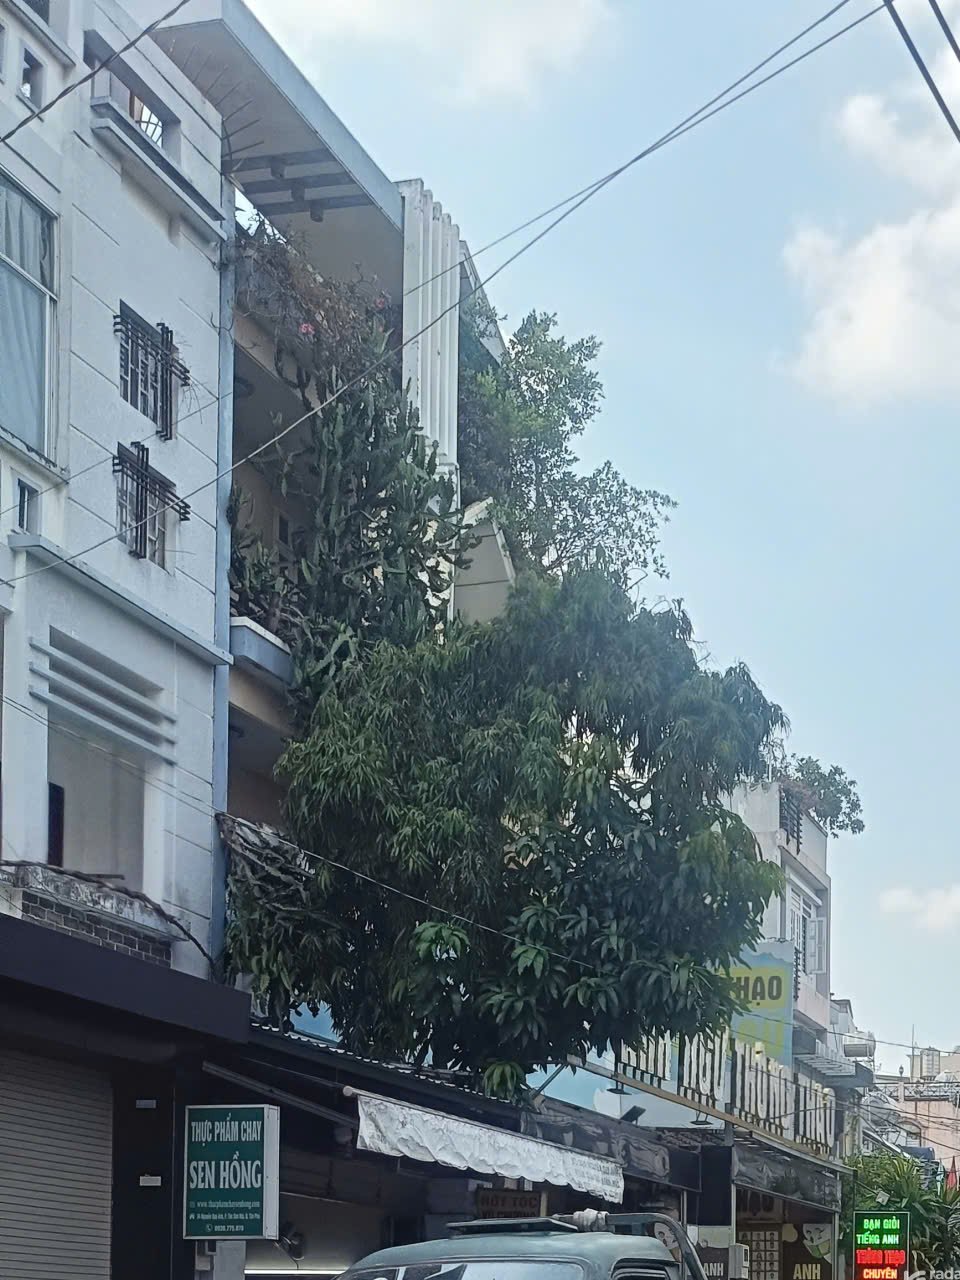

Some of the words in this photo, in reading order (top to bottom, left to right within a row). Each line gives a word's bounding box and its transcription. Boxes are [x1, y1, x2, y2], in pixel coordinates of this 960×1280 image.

[736, 975, 783, 1006] HẠO
[191, 1119, 212, 1147] THỰC
[214, 1112, 239, 1142] PHẨM
[240, 1120, 262, 1142] CHAY
[189, 1160, 216, 1189] SEN
[219, 1150, 262, 1189] HỒNG
[863, 1218, 881, 1230] BẠN
[882, 1234, 899, 1244] ANH
[793, 1263, 821, 1280] ANH
[863, 1267, 898, 1279] CHUYÊN
